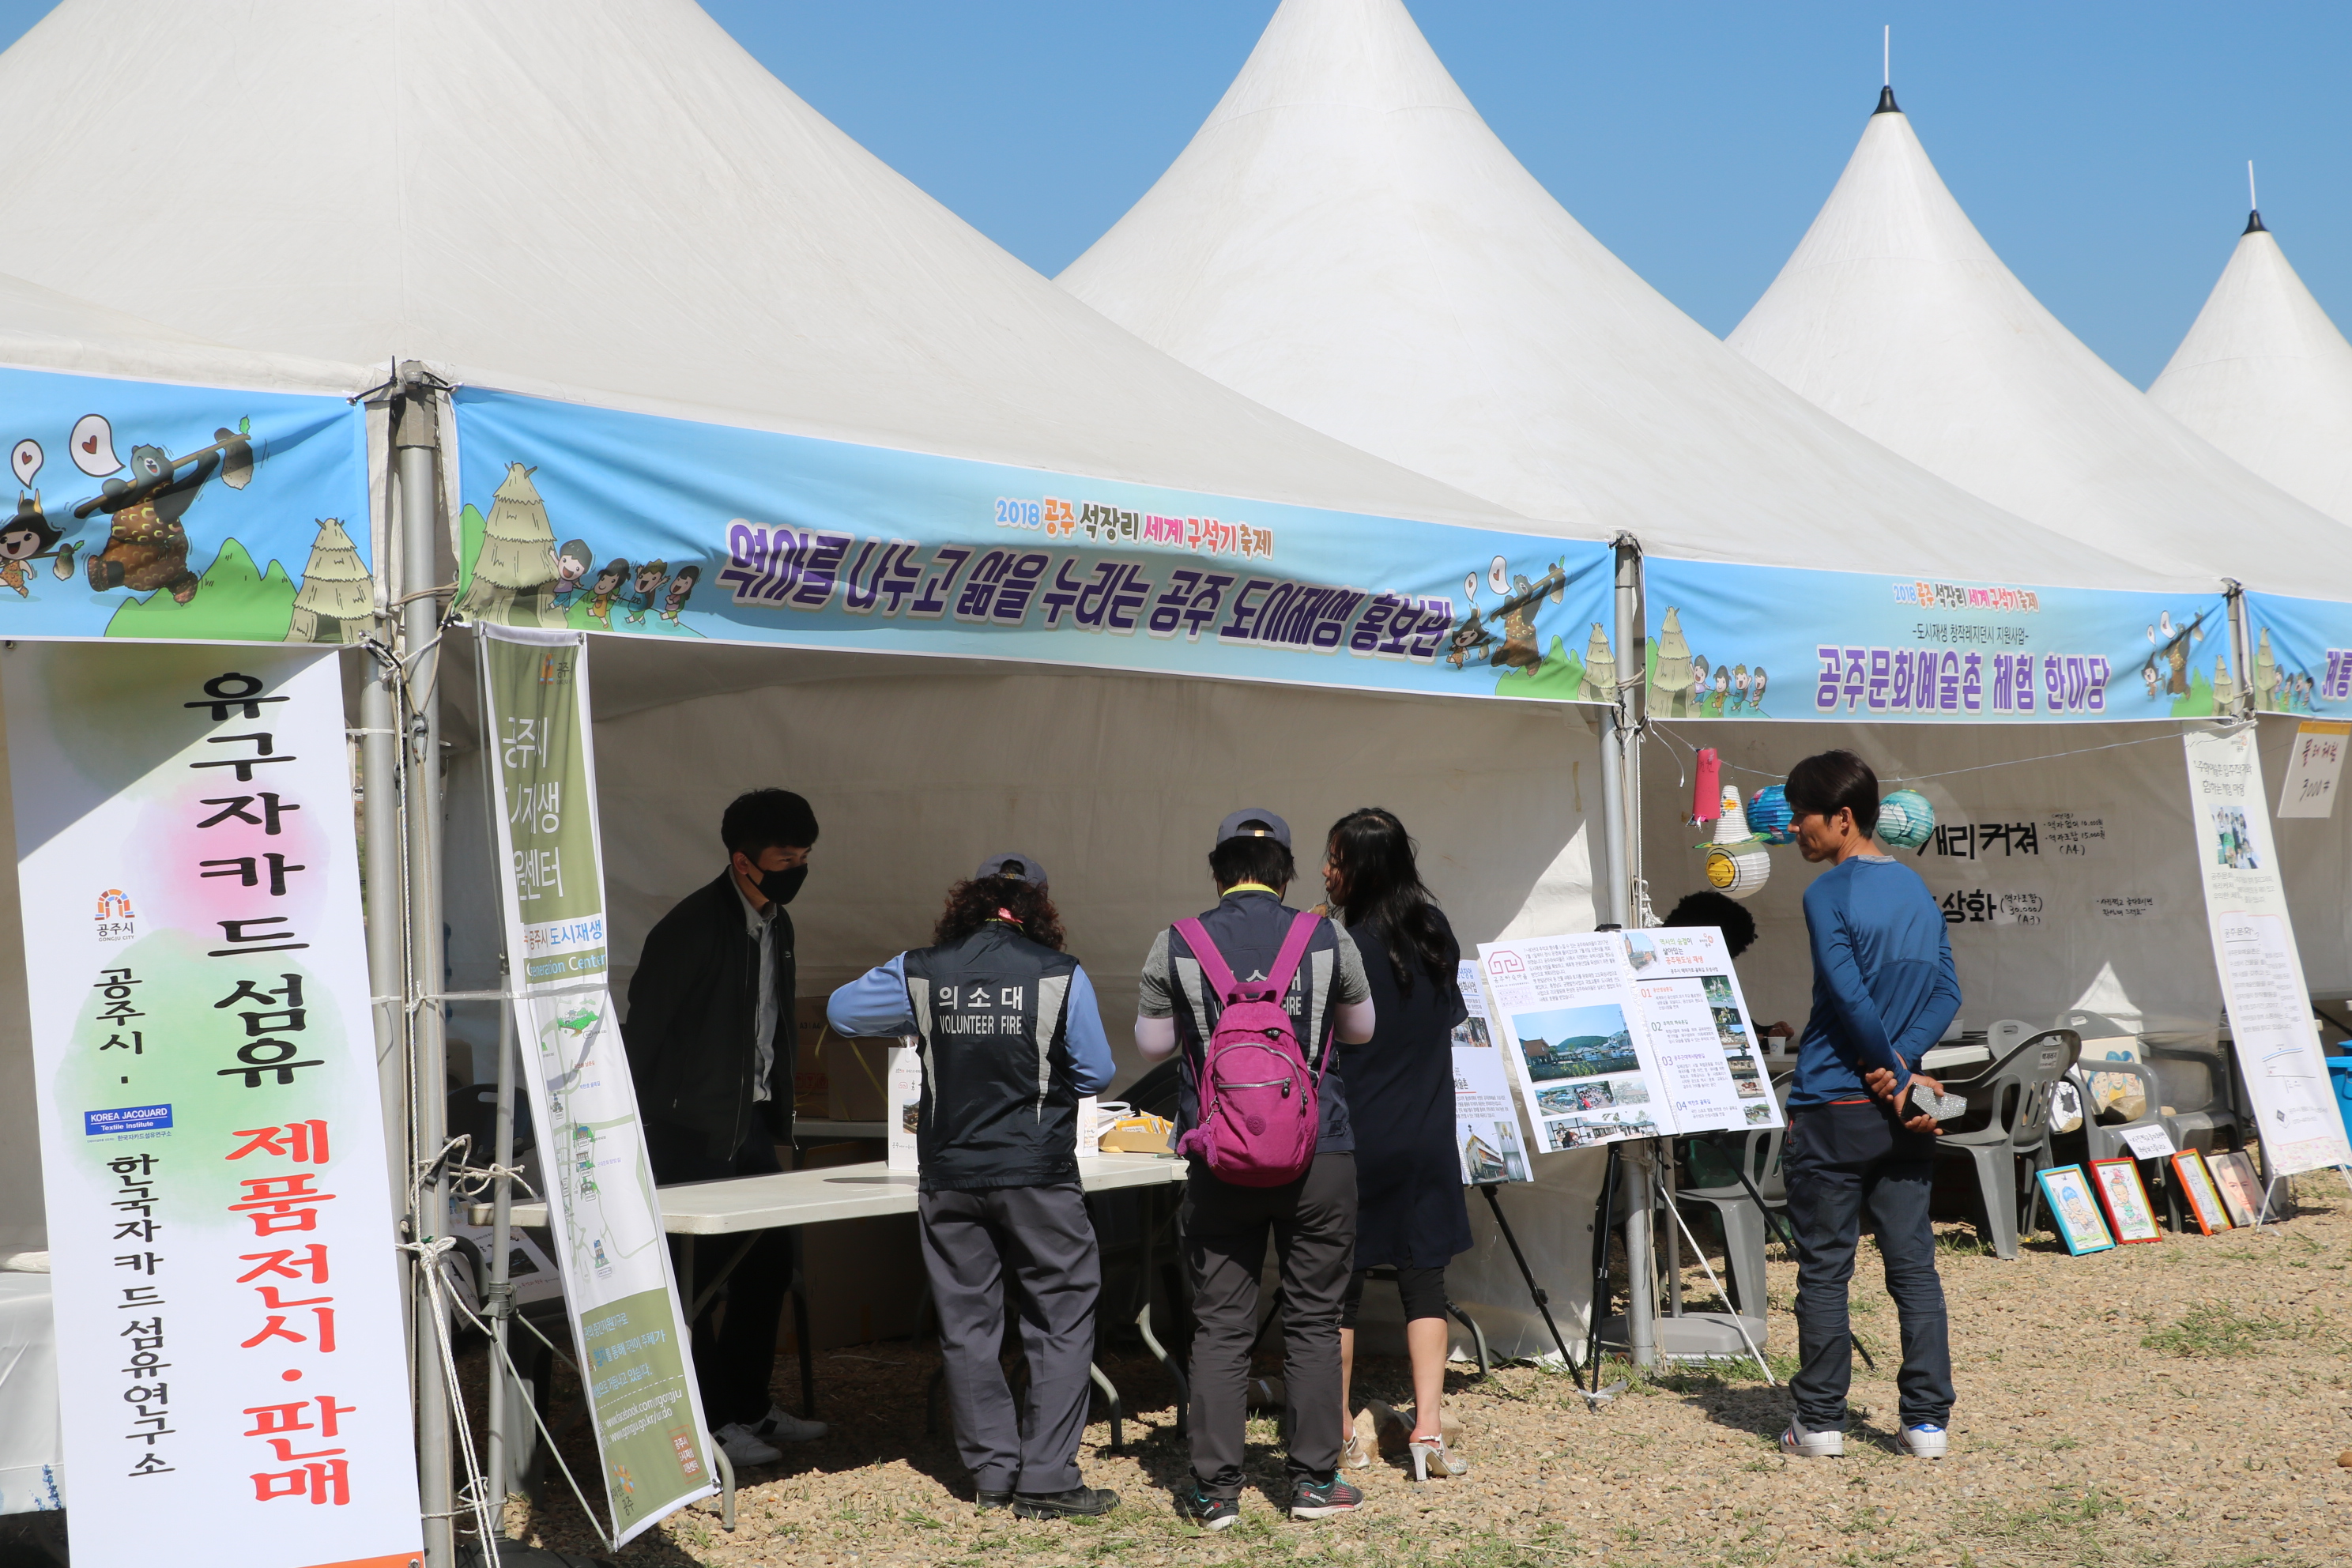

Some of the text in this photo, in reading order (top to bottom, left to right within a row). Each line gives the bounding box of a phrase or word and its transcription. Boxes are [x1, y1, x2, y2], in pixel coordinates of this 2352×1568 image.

[997, 499, 1040, 526] 2018
[1044, 499, 1075, 535] 공주
[1080, 502, 1140, 541] 석장리
[1894, 586, 1917, 601] 2018
[1917, 582, 1934, 607] 공주
[956, 550, 1050, 621] 삶을
[1150, 569, 1235, 636] 공주
[1220, 580, 1367, 646] 도시재생
[1351, 593, 1453, 658] 홍보관
[556, 662, 572, 679] 공주
[1816, 646, 2111, 711] 공주문화예술촌 체험 한마당
[1933, 889, 1996, 923] 상화
[96, 922, 134, 937] 공주시
[550, 919, 602, 945] 도시재생
[1677, 937, 1693, 946] 숨결이
[569, 954, 605, 971] Center
[1666, 956, 1704, 965] 공주원도심 재생
[1641, 988, 1652, 998] 01
[940, 1015, 1022, 1035] VOLUNTEER FIRE
[1651, 1021, 1663, 1031] 02
[1662, 1056, 1673, 1066] 03
[1676, 1101, 1687, 1111] 04
[91, 1108, 168, 1122] KOREA JACQUARD
[126, 1121, 154, 1129] Institute
[117, 1131, 172, 1142] 한국자카드섬유연구소
[1310, 1493, 1326, 1503] Reebok
